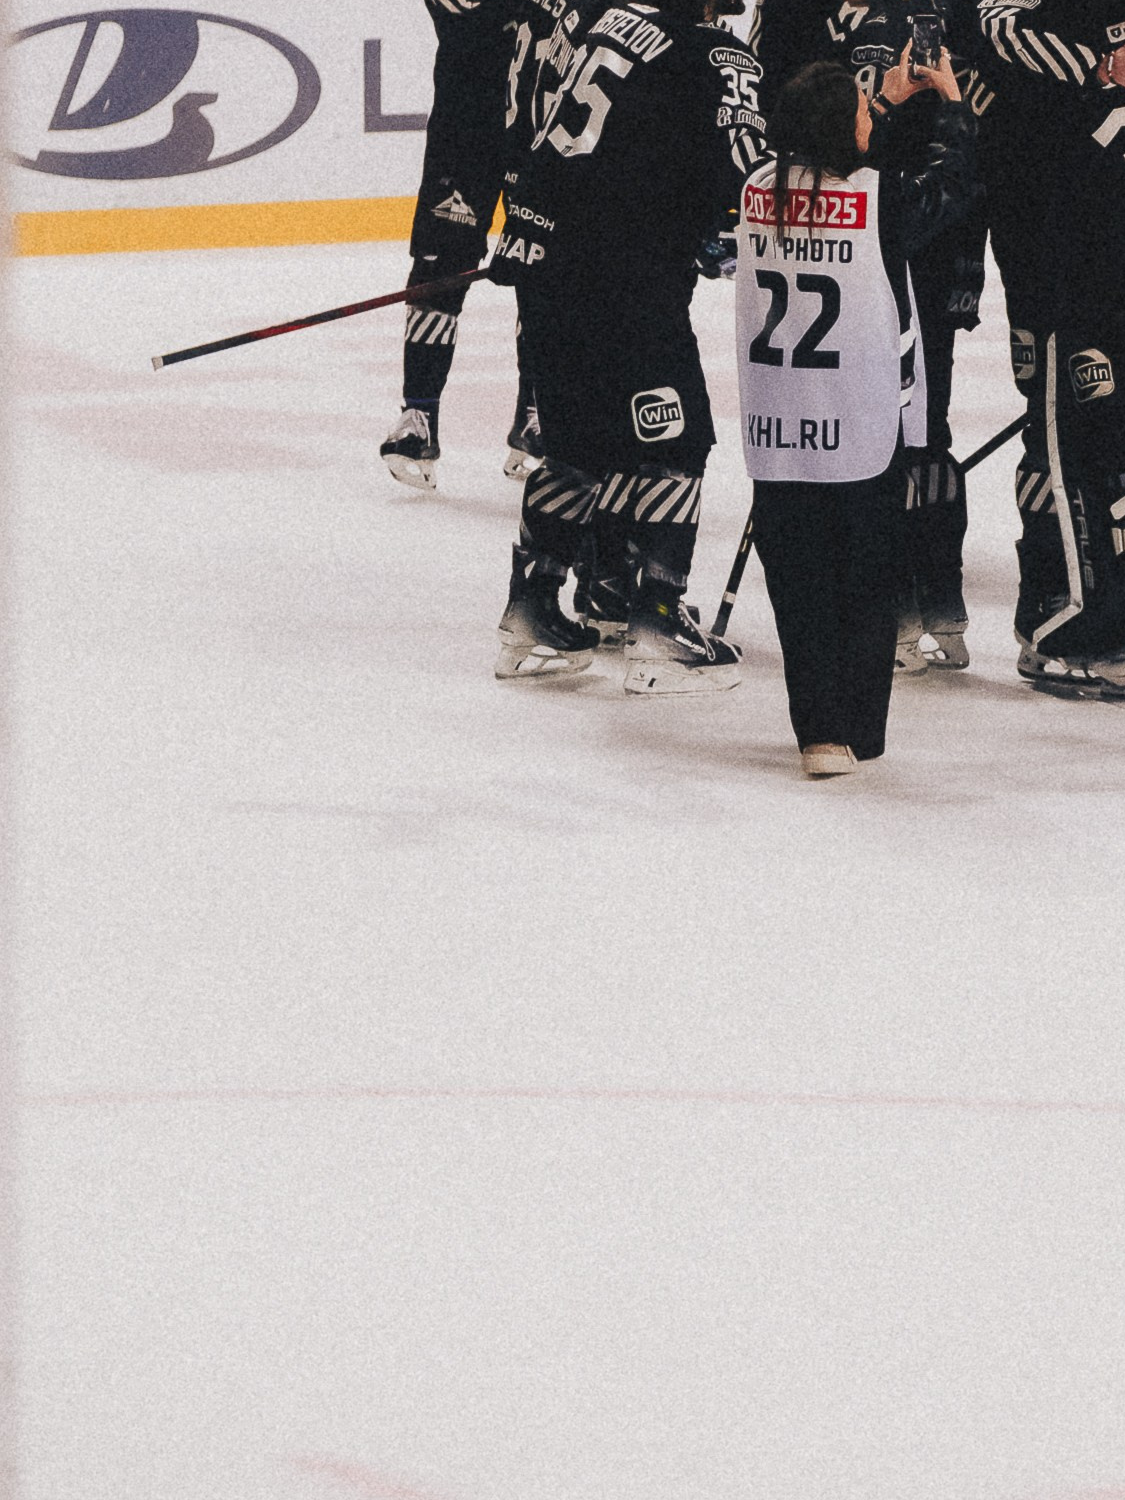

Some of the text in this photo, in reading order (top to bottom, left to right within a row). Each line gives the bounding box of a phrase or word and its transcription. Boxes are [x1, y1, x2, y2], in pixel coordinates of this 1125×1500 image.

[720, 66, 760, 112] 35
[745, 191, 857, 224] 202/2025
[495, 233, 546, 265] НАР
[783, 236, 853, 264] PHOTO
[749, 269, 840, 369] 22
[1077, 366, 1109, 383] Win
[643, 405, 680, 424] Win
[747, 412, 841, 451] KHL.RU
